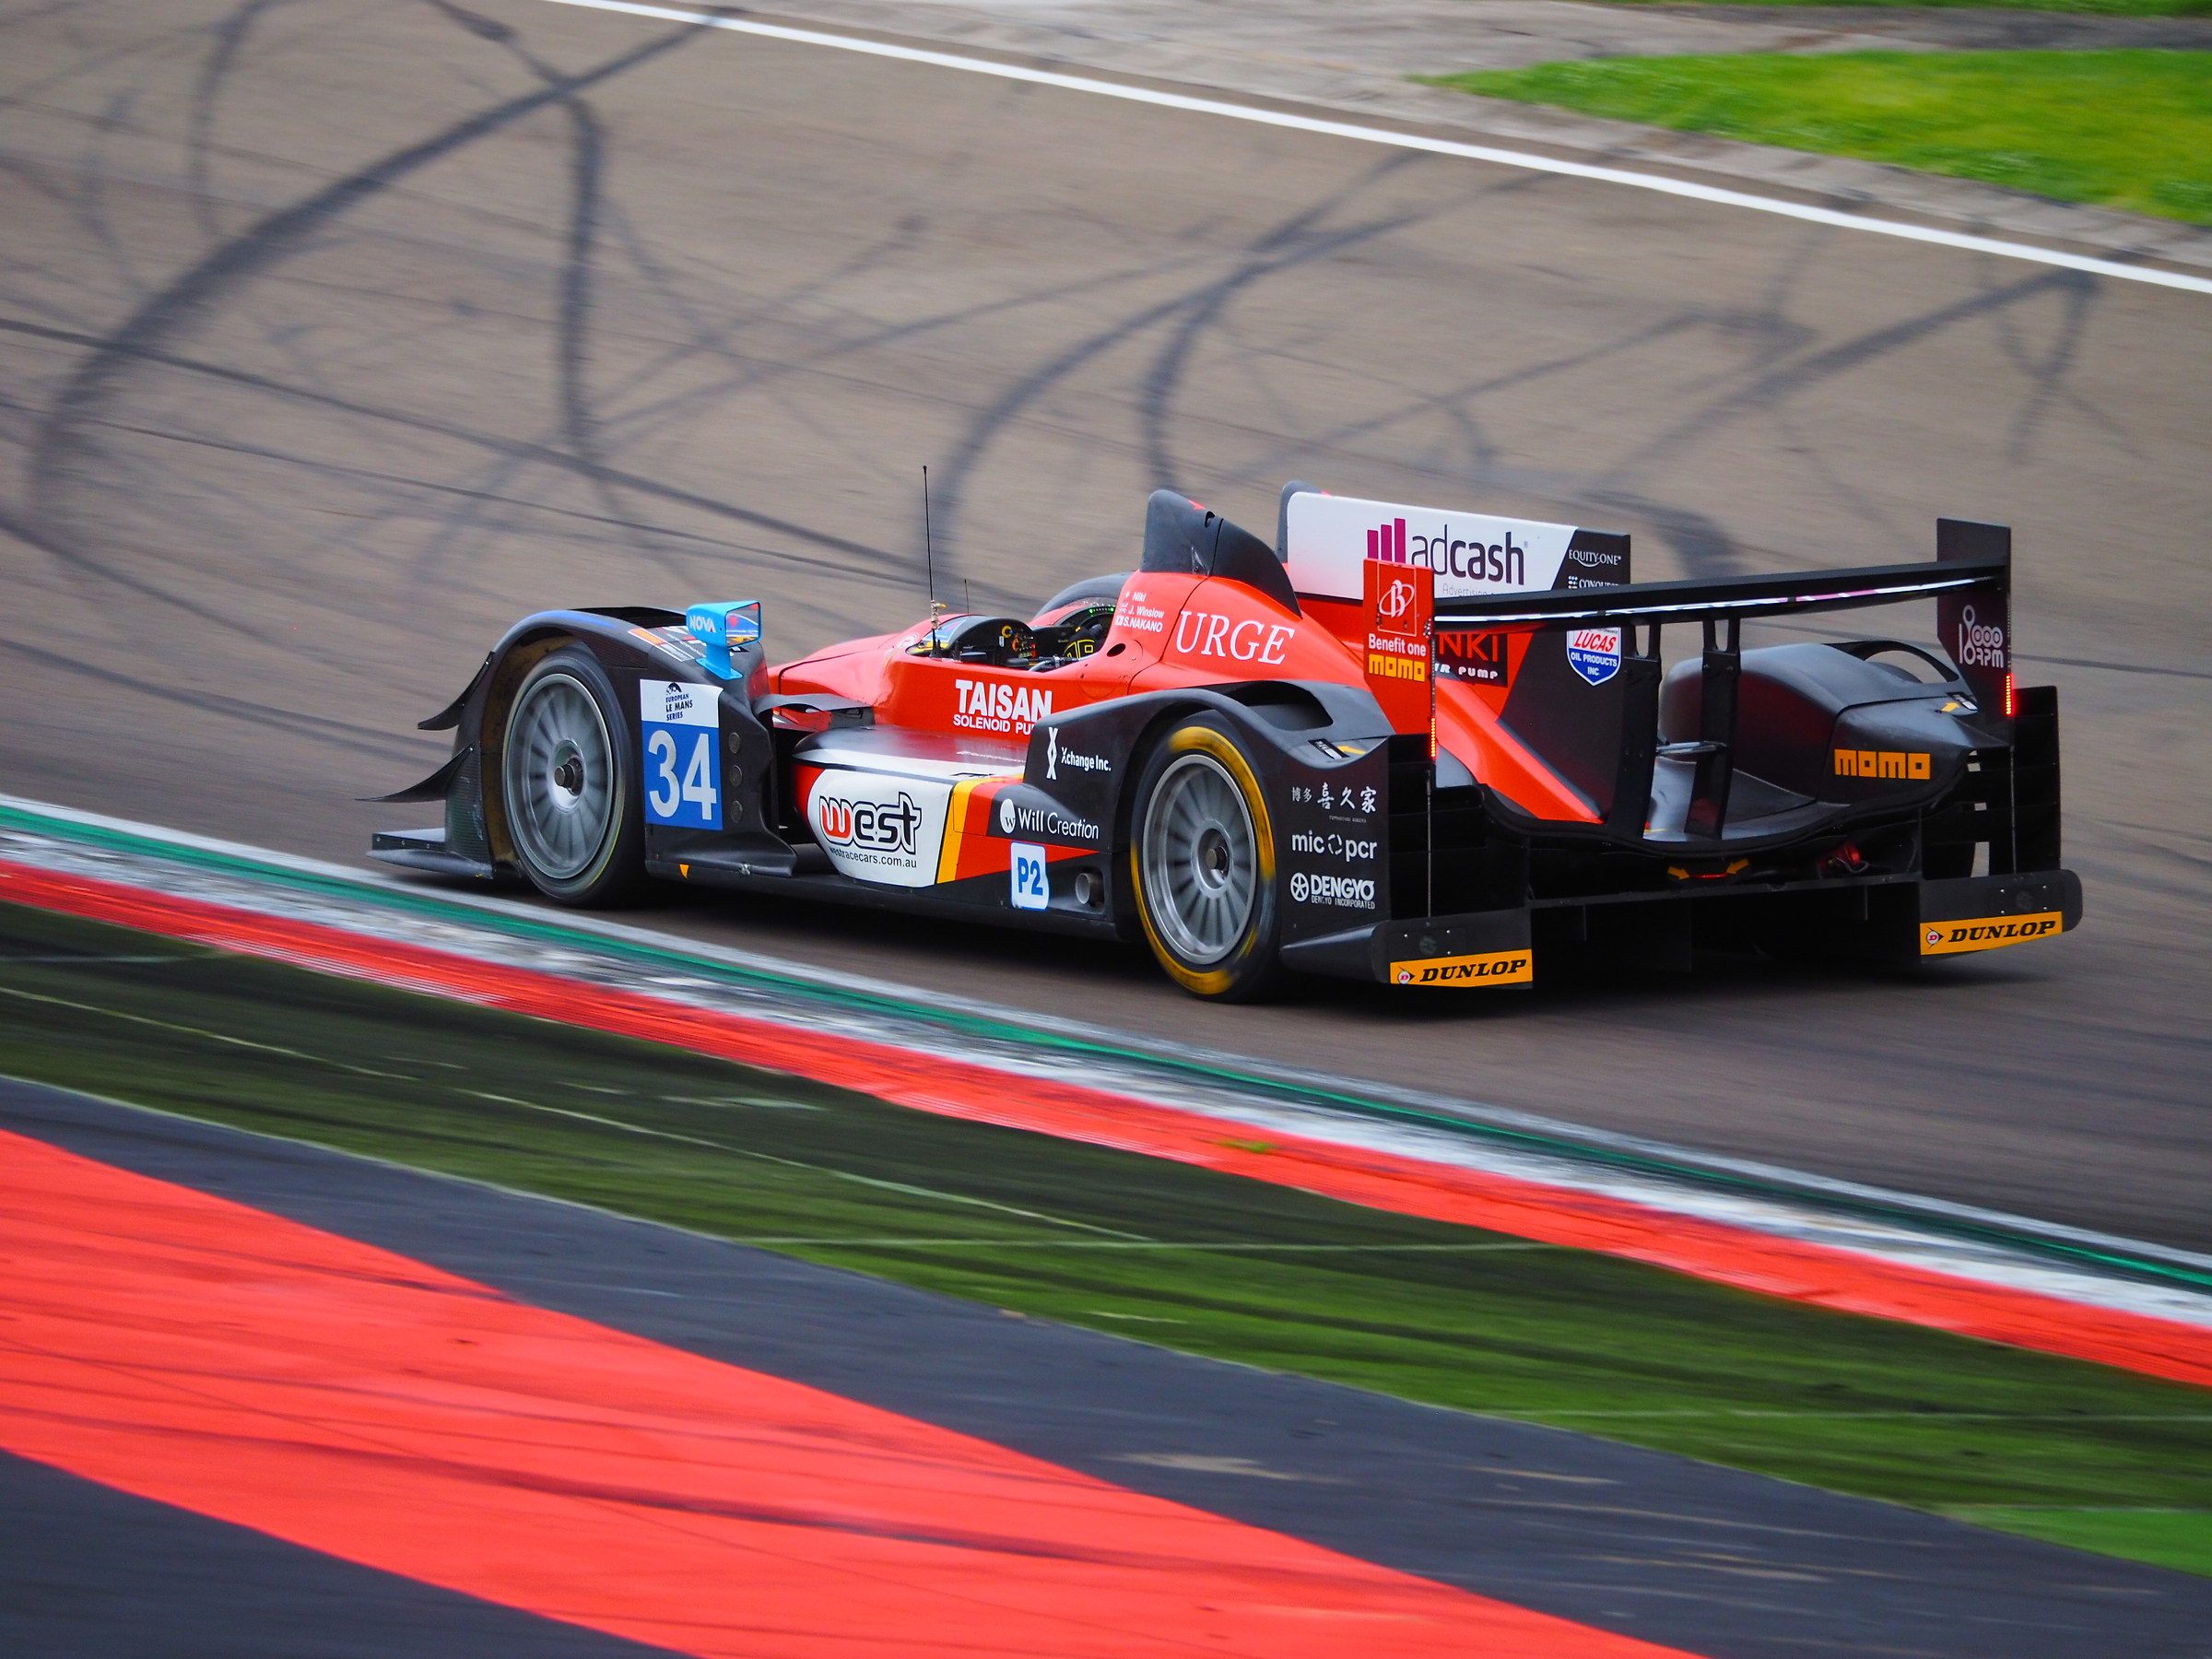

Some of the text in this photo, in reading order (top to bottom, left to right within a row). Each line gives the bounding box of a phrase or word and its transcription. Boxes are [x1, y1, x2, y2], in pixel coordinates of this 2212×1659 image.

[1411, 524, 1524, 585] adcash
[1137, 606, 1165, 618] Winslow
[689, 615, 716, 633] NOVA
[1124, 617, 1163, 632] S.NAKANO
[1175, 610, 1295, 665] URGE
[1368, 632, 1427, 657] Benefit one
[1573, 630, 1617, 653] LUCAS
[1571, 652, 1618, 667] OIL PRODUCTS
[665, 693, 689, 703] EUROPEAN
[665, 700, 693, 712] LE MANS
[955, 679, 1053, 723] TAISAN
[666, 711, 684, 721] SERIES
[953, 713, 1034, 735] SOLENOID PU
[1061, 747, 1112, 772] Xchange Inc.
[648, 729, 717, 821] 34
[1018, 807, 1100, 840] Will Creation
[830, 846, 917, 868] westracecars.com.au
[1017, 856, 1043, 896] P2
[1311, 874, 1375, 901] DENGYO
[1335, 898, 1376, 910] INCORPORATED
[1947, 920, 2056, 943] DUNLOP
[1418, 959, 1527, 982] DUNLOP
